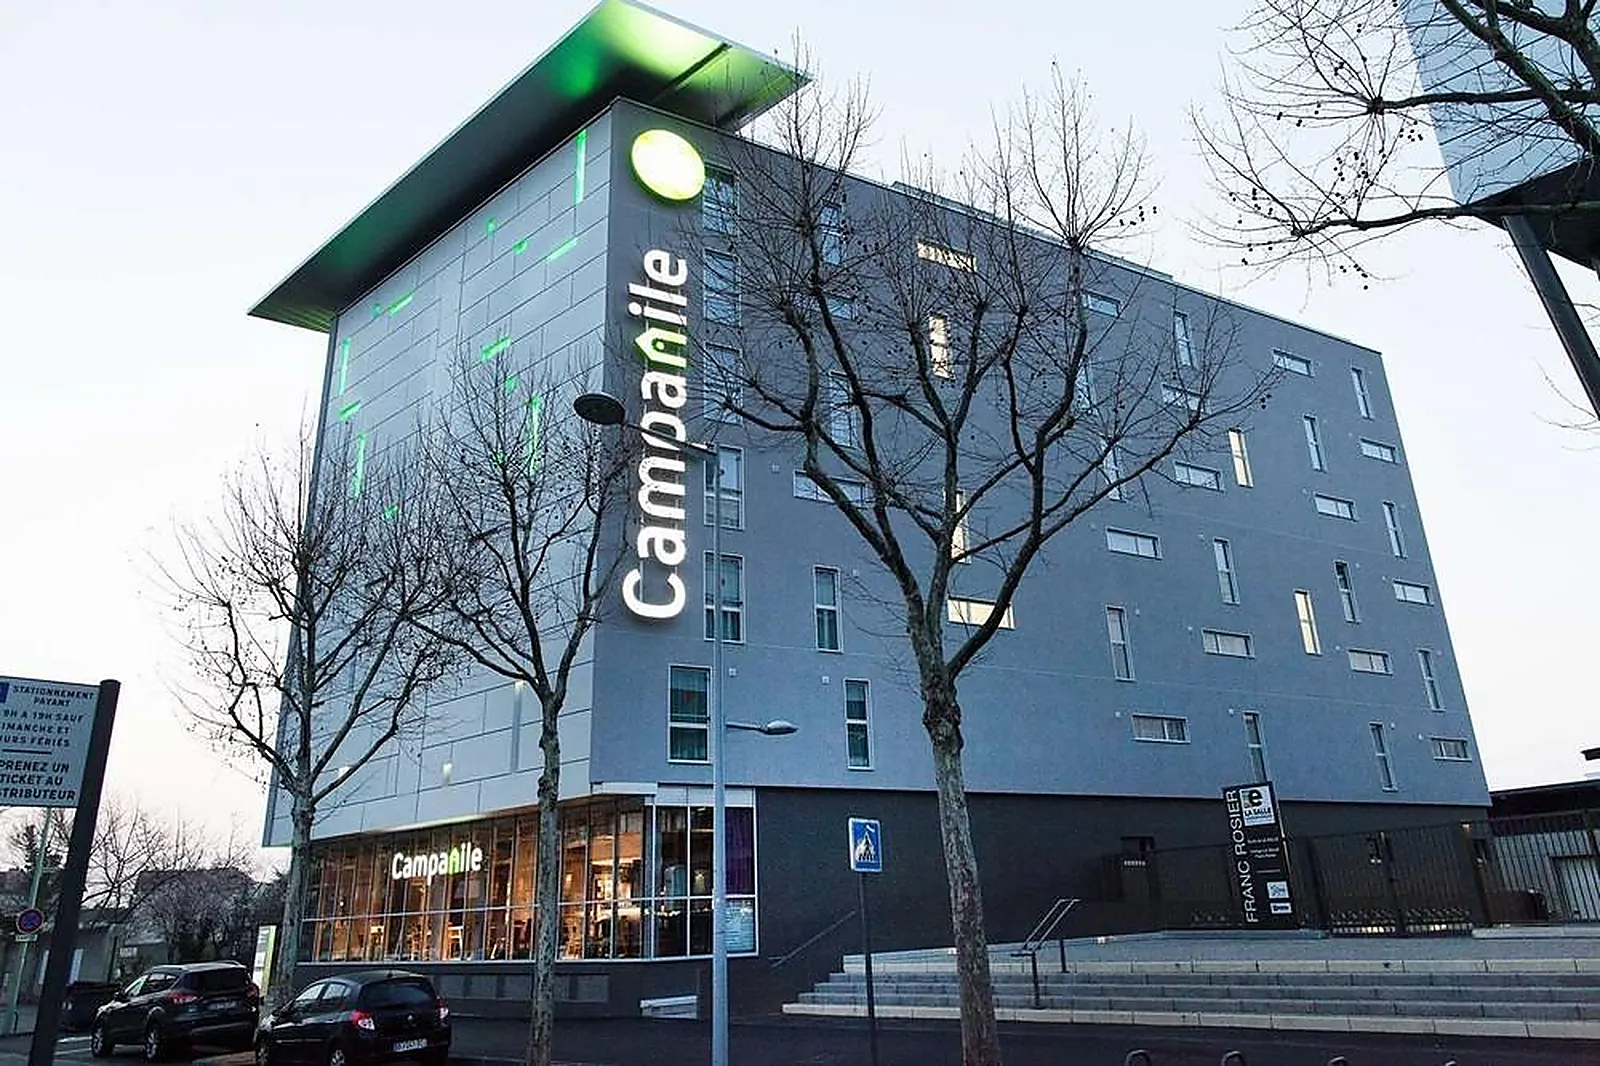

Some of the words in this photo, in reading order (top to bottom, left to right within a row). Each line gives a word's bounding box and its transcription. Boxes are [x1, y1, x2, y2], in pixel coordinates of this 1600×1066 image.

[622, 248, 688, 620] Campanile
[12, 685, 94, 700] STATIONNEMENT
[33, 697, 71, 707] PAYANT
[56, 713, 84, 723] SAUF
[1, 722, 54, 734] IMANCHE
[57, 726, 69, 734] ET
[0, 735, 26, 744] URS
[52, 762, 70, 773] UN
[0, 773, 43, 785] TICKET
[45, 776, 63, 786] AU
[0, 787, 76, 800] TRIBUTEUR
[1225, 790, 1246, 856] ROSIER
[391, 841, 483, 887] Campanile
[1237, 860, 1259, 923] FRANC
